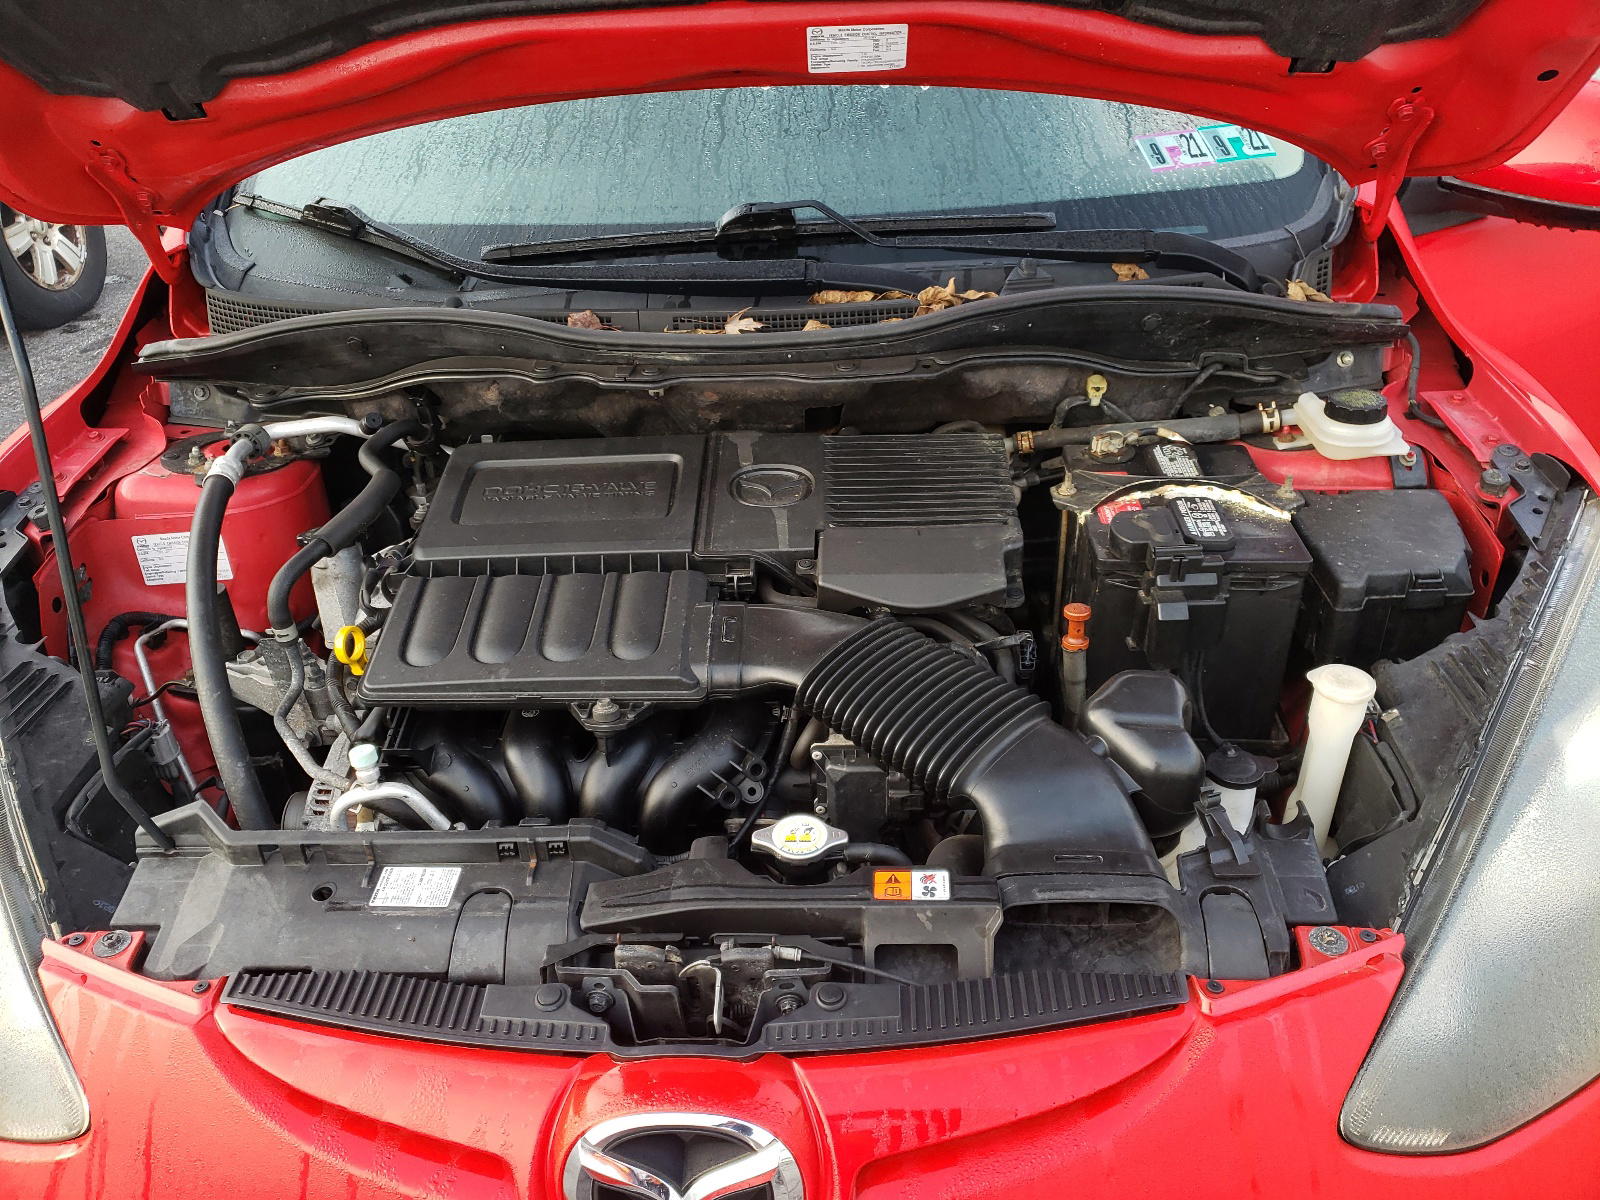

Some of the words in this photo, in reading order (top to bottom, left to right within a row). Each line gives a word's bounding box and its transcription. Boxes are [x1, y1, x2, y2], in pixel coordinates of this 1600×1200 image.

[1149, 142, 1166, 164] 9
[1179, 133, 1208, 158] 21
[1213, 135, 1230, 156] 9
